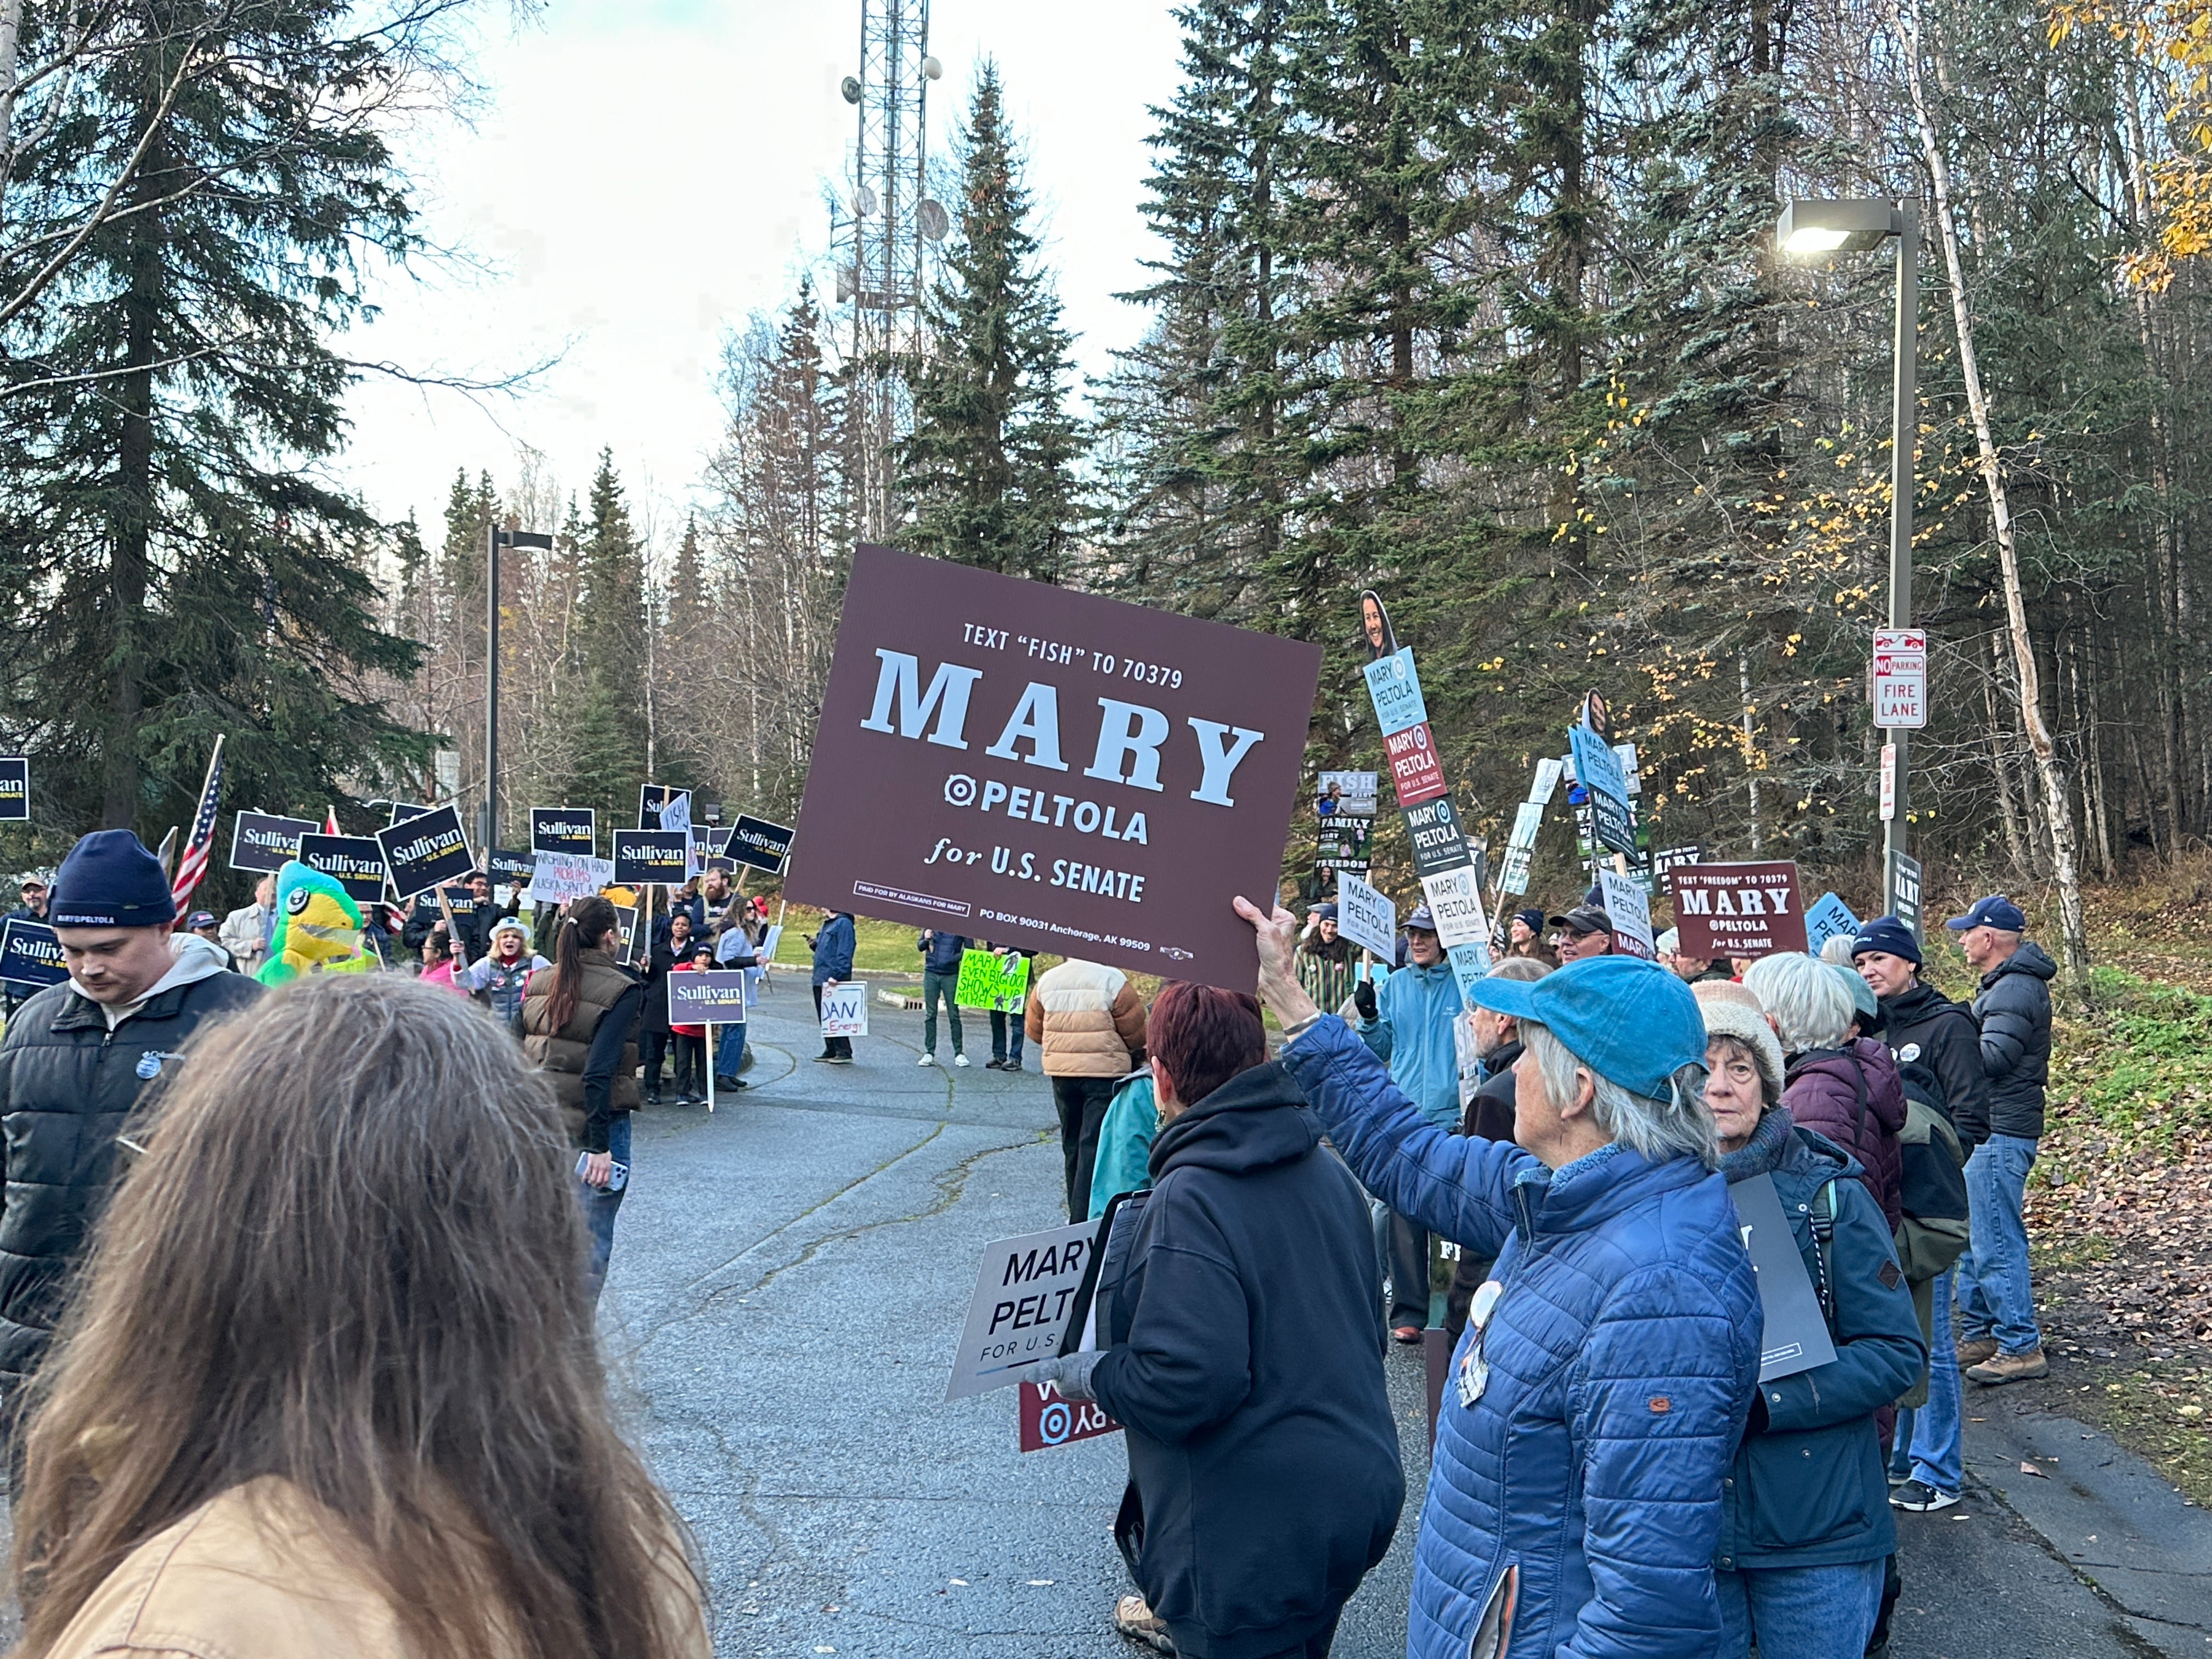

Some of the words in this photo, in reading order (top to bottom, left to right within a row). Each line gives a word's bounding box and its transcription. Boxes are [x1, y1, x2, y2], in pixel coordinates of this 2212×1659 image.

[964, 623, 1009, 650] TEXT
[1093, 652, 1115, 674] TO
[1122, 659, 1182, 689] 70379
[1876, 659, 1891, 673] NO
[1892, 661, 1922, 670] PARKING
[1369, 662, 1393, 686] MARY
[1376, 680, 1414, 708] PELTOLA
[1884, 684, 1915, 698] FIRE
[1882, 703, 1918, 716] LANE
[859, 647, 1265, 808] MARY
[1388, 731, 1414, 755] MARY
[1584, 733, 1608, 757] MARY
[1394, 750, 1436, 778] PELTOLA
[1587, 751, 1621, 782] PELTOLA
[1321, 775, 1374, 790] FISH
[1400, 781, 1412, 791] FOR
[1421, 771, 1440, 784] SENATE
[981, 780, 1147, 845] PELTOLA
[1594, 791, 1618, 815] MARY
[665, 801, 686, 830] FISH
[1321, 817, 1370, 828] FAMILY
[1408, 805, 1436, 827] MARY
[1597, 809, 1633, 843] PELTOLA
[244, 828, 300, 849] Sulliva
[538, 821, 591, 835] Sullivan
[1414, 824, 1459, 849] PELTOLA
[393, 829, 462, 866] Sullivan
[426, 853, 440, 861] U.S.
[440, 842, 465, 856] SENATE
[622, 845, 684, 860] Sullivan
[737, 829, 786, 853] Sullivan
[1420, 851, 1431, 860] FOR
[1432, 849, 1442, 857] U.S.
[1443, 844, 1463, 856] SENATE
[308, 853, 383, 873] Sullivan
[492, 857, 535, 873] Sullivan
[536, 851, 589, 870] WASHINGTON
[592, 859, 609, 873] HAD
[924, 838, 982, 865] for
[991, 846, 1042, 882] U.S.
[1050, 859, 1145, 902] SENATE
[1316, 859, 1367, 868] FREEDOM
[534, 878, 561, 890] ALASKA
[562, 882, 584, 893] SENT
[588, 884, 594, 895] A
[1430, 877, 1458, 898] MARY
[1608, 877, 1636, 900] MARY
[1678, 876, 1697, 885] TEXT
[1745, 876, 1757, 884] TO
[1760, 874, 1787, 883] 70379
[420, 894, 473, 909] Sulvan
[859, 885, 873, 893] PAID
[899, 894, 932, 905] ALASKANS
[947, 903, 966, 912] MARY
[1348, 881, 1377, 909] MARY
[1679, 888, 1790, 916] MARY
[1348, 901, 1390, 938] PELTOLA
[1437, 898, 1477, 919] PELTOLA
[1612, 895, 1647, 924] PELTOLA
[980, 909, 994, 919] PO
[996, 912, 1018, 924] BOX
[1019, 916, 1048, 930] 90031
[1050, 923, 1102, 943] Anchorage,
[1104, 934, 1117, 945] AK
[1119, 938, 1150, 951] 99509
[1443, 922, 1453, 932] FOR
[1827, 906, 1858, 936] MAR
[10, 938, 66, 961] Sulliv
[1617, 934, 1646, 957] MARY
[1712, 938, 1726, 949] for
[1728, 938, 1742, 949] U.S.
[1743, 938, 1773, 949] SENATE
[964, 954, 1000, 968] MARY
[1455, 949, 1479, 967] MARY
[962, 966, 987, 979] EVEN
[989, 969, 1025, 988] BIGFOOT
[677, 985, 740, 1000] Sullivan
[956, 992, 988, 1007] MORE!
[958, 977, 1000, 997] SHOWS
[1004, 989, 1020, 1001] UP
[988, 1287, 1075, 1335] PELT
[980, 1341, 1018, 1362] FOR
[1026, 1334, 1059, 1351] U.S.
